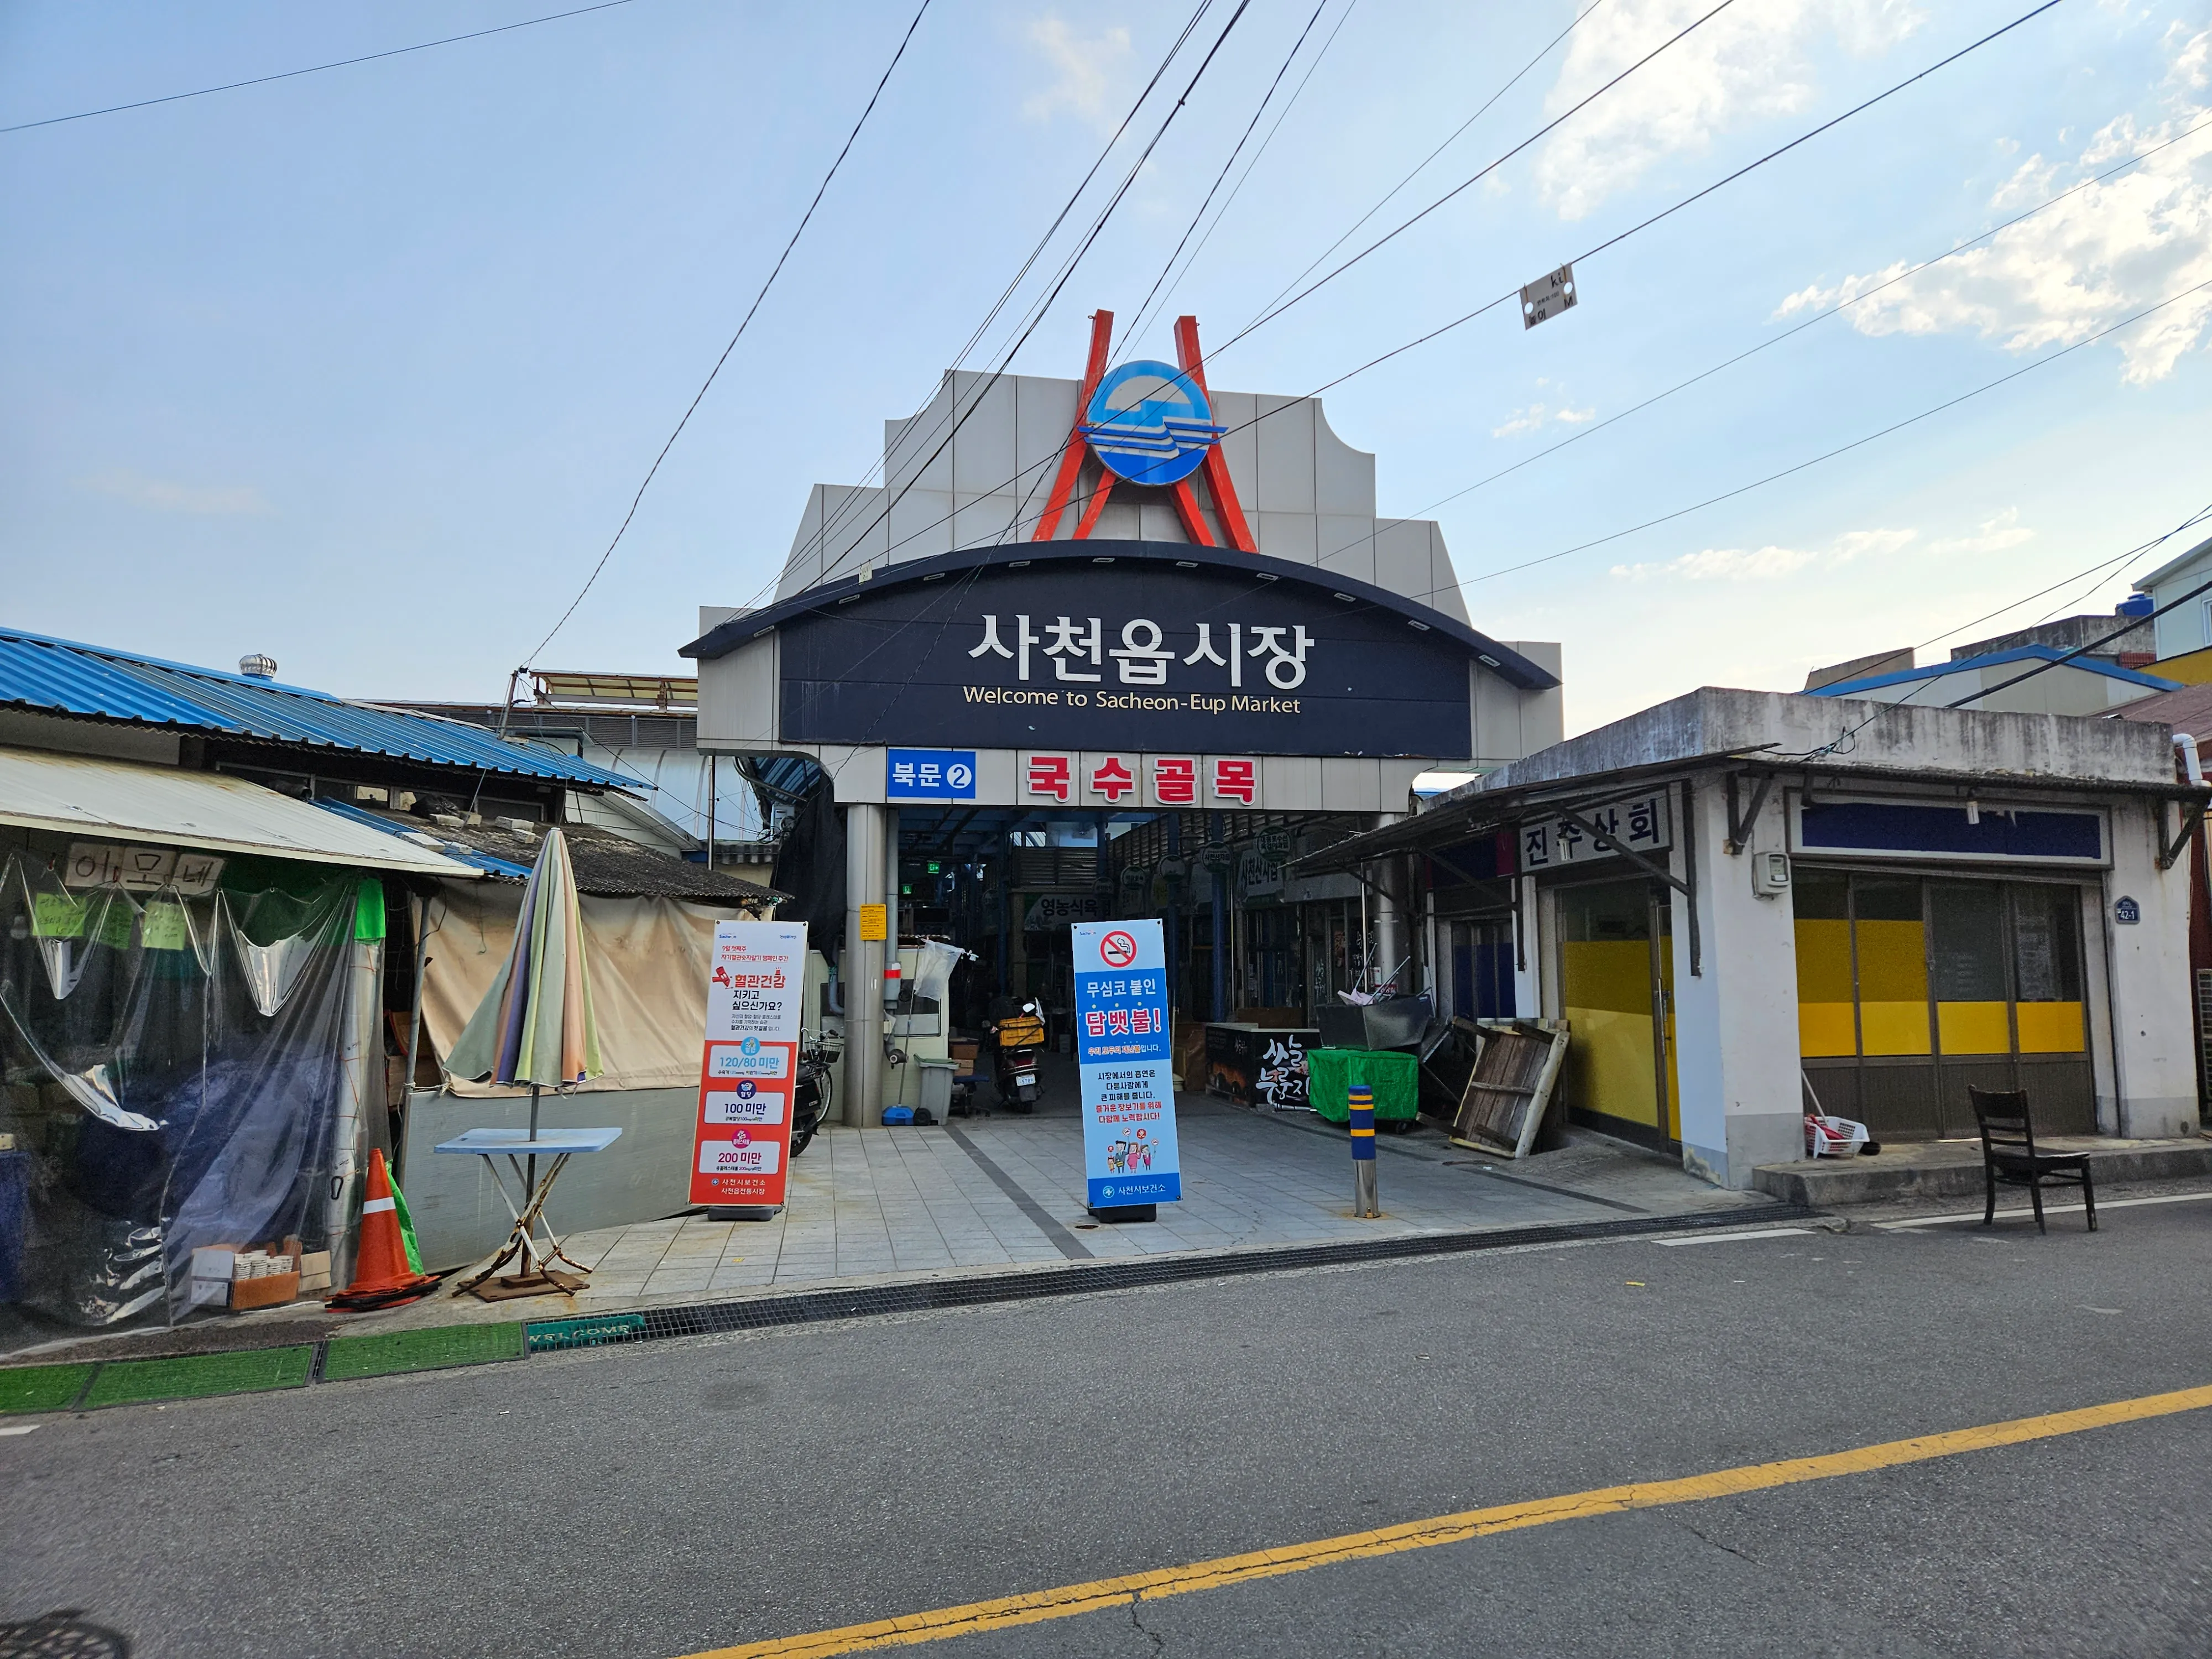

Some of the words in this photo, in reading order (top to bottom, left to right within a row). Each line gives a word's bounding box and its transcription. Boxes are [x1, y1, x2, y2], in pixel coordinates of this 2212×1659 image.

[1564, 296, 1573, 309] M
[968, 614, 1315, 690] 사천읍시장
[963, 686, 1058, 705] Welcome
[1066, 691, 1088, 706] to
[1095, 691, 1226, 714] Sacheon-Eup
[1231, 695, 1301, 714] Market
[892, 761, 942, 788] 북문
[1029, 755, 1257, 806] 국수골목
[1526, 799, 1659, 866] 진주상회
[2120, 910, 2135, 919] 42-1
[735, 974, 786, 988] 혈관건강
[1087, 980, 1126, 998] 무심코
[1130, 978, 1156, 996] 붙인
[733, 990, 760, 999] 지키고
[732, 1001, 782, 1011] 싶으신가요?
[1086, 1008, 1162, 1036] 담뱃불!
[1088, 1047, 1101, 1056] 우리
[1102, 1046, 1121, 1055] 모두의
[719, 1057, 757, 1068] 120/80
[759, 1057, 780, 1069] 미만
[1098, 1071, 1133, 1080] 시장에서의
[1135, 1070, 1155, 1078] 흡연은
[1106, 1081, 1149, 1091] 다른사람에게
[1109, 1092, 1130, 1101] 피해를
[1131, 1091, 1155, 1100] 줍니다.
[724, 1103, 743, 1113] 100
[745, 1103, 766, 1115] 미만
[1096, 1104, 1117, 1113] 즐거운
[1118, 1103, 1146, 1112] 장보기를
[1147, 1101, 1162, 1109] 위해
[1099, 1115, 1120, 1123] 다함께
[1122, 1113, 1160, 1122] 노력합시다!
[718, 1152, 738, 1163] 200
[740, 1152, 762, 1164] 미만
[1118, 1184, 1166, 1195] 사천시보건소
